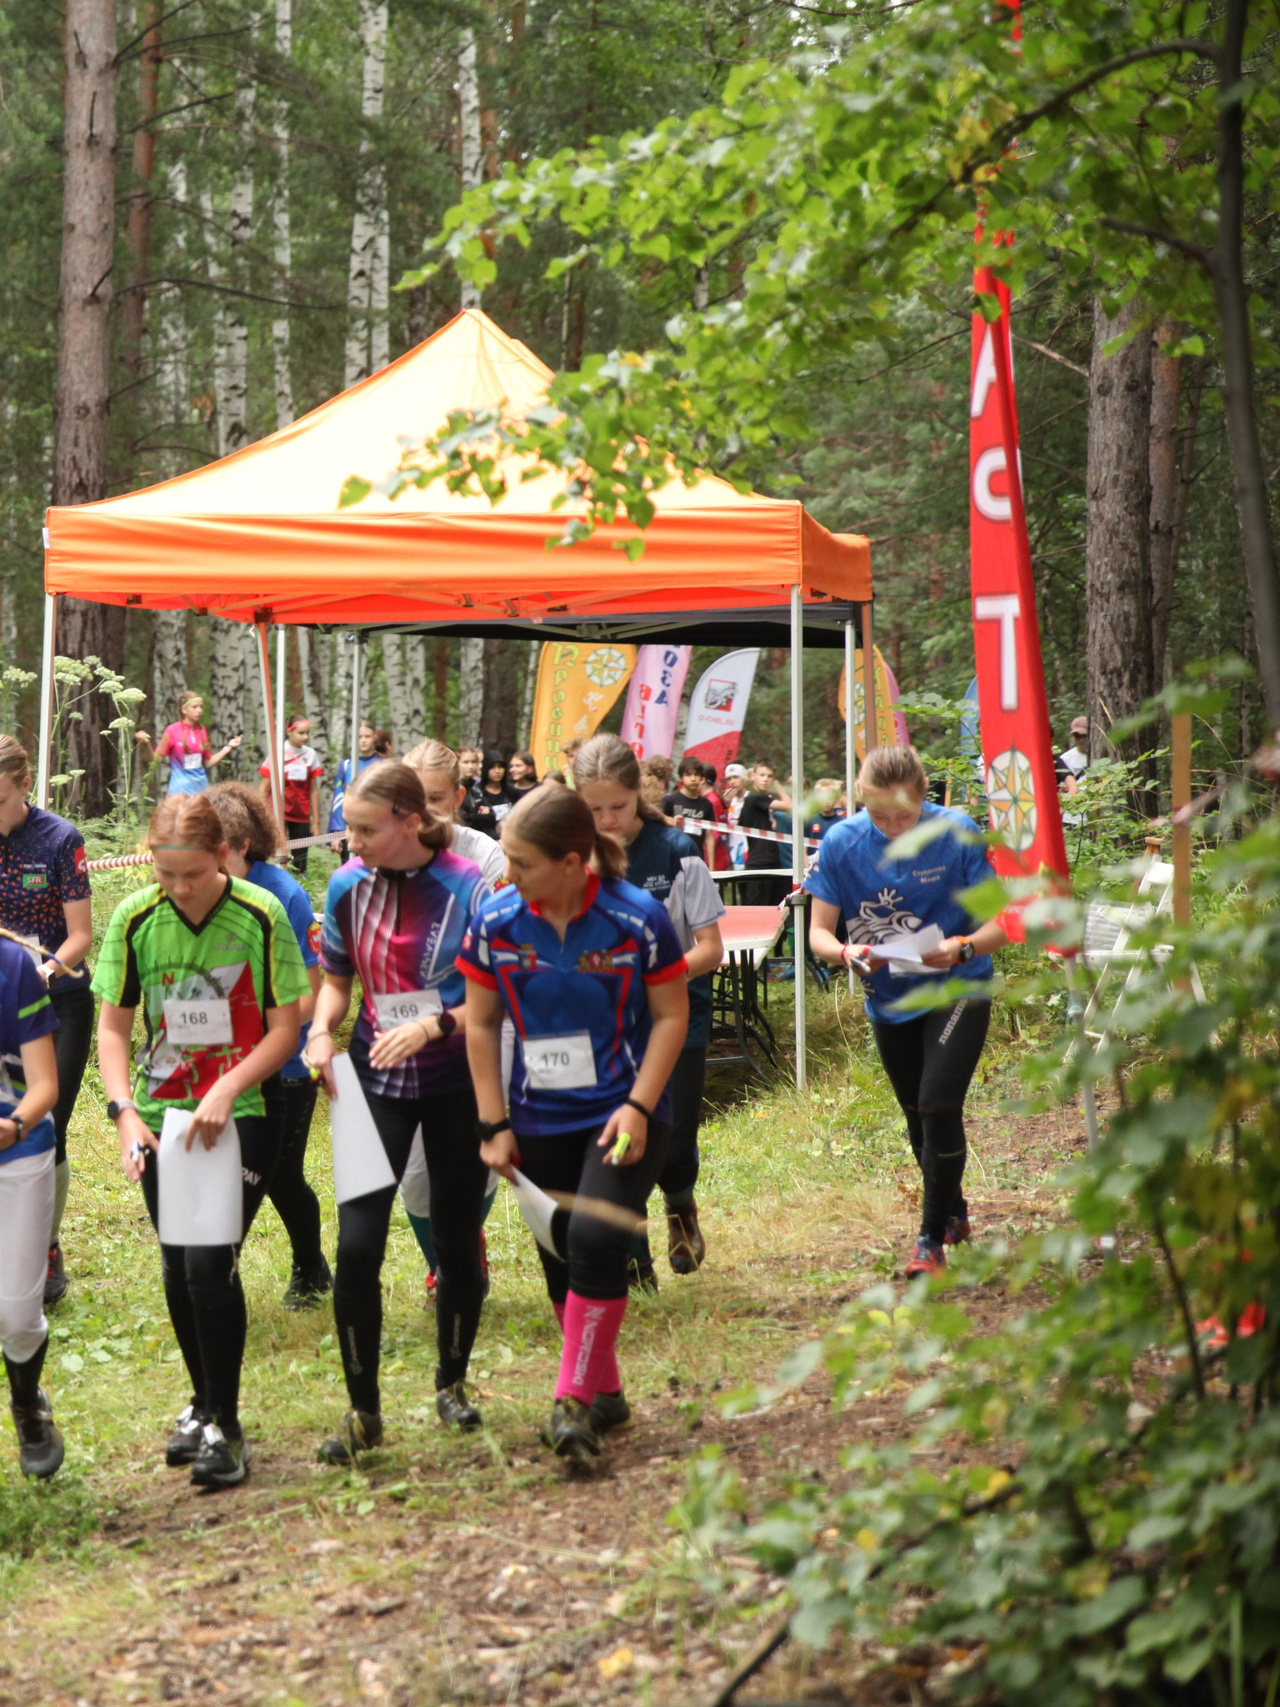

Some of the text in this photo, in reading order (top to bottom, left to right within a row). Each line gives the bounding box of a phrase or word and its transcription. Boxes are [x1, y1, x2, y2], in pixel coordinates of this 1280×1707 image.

[682, 808, 704, 818] FILA
[180, 1011, 208, 1025] 168
[390, 1003, 419, 1019] 169
[542, 1051, 570, 1067] 170
